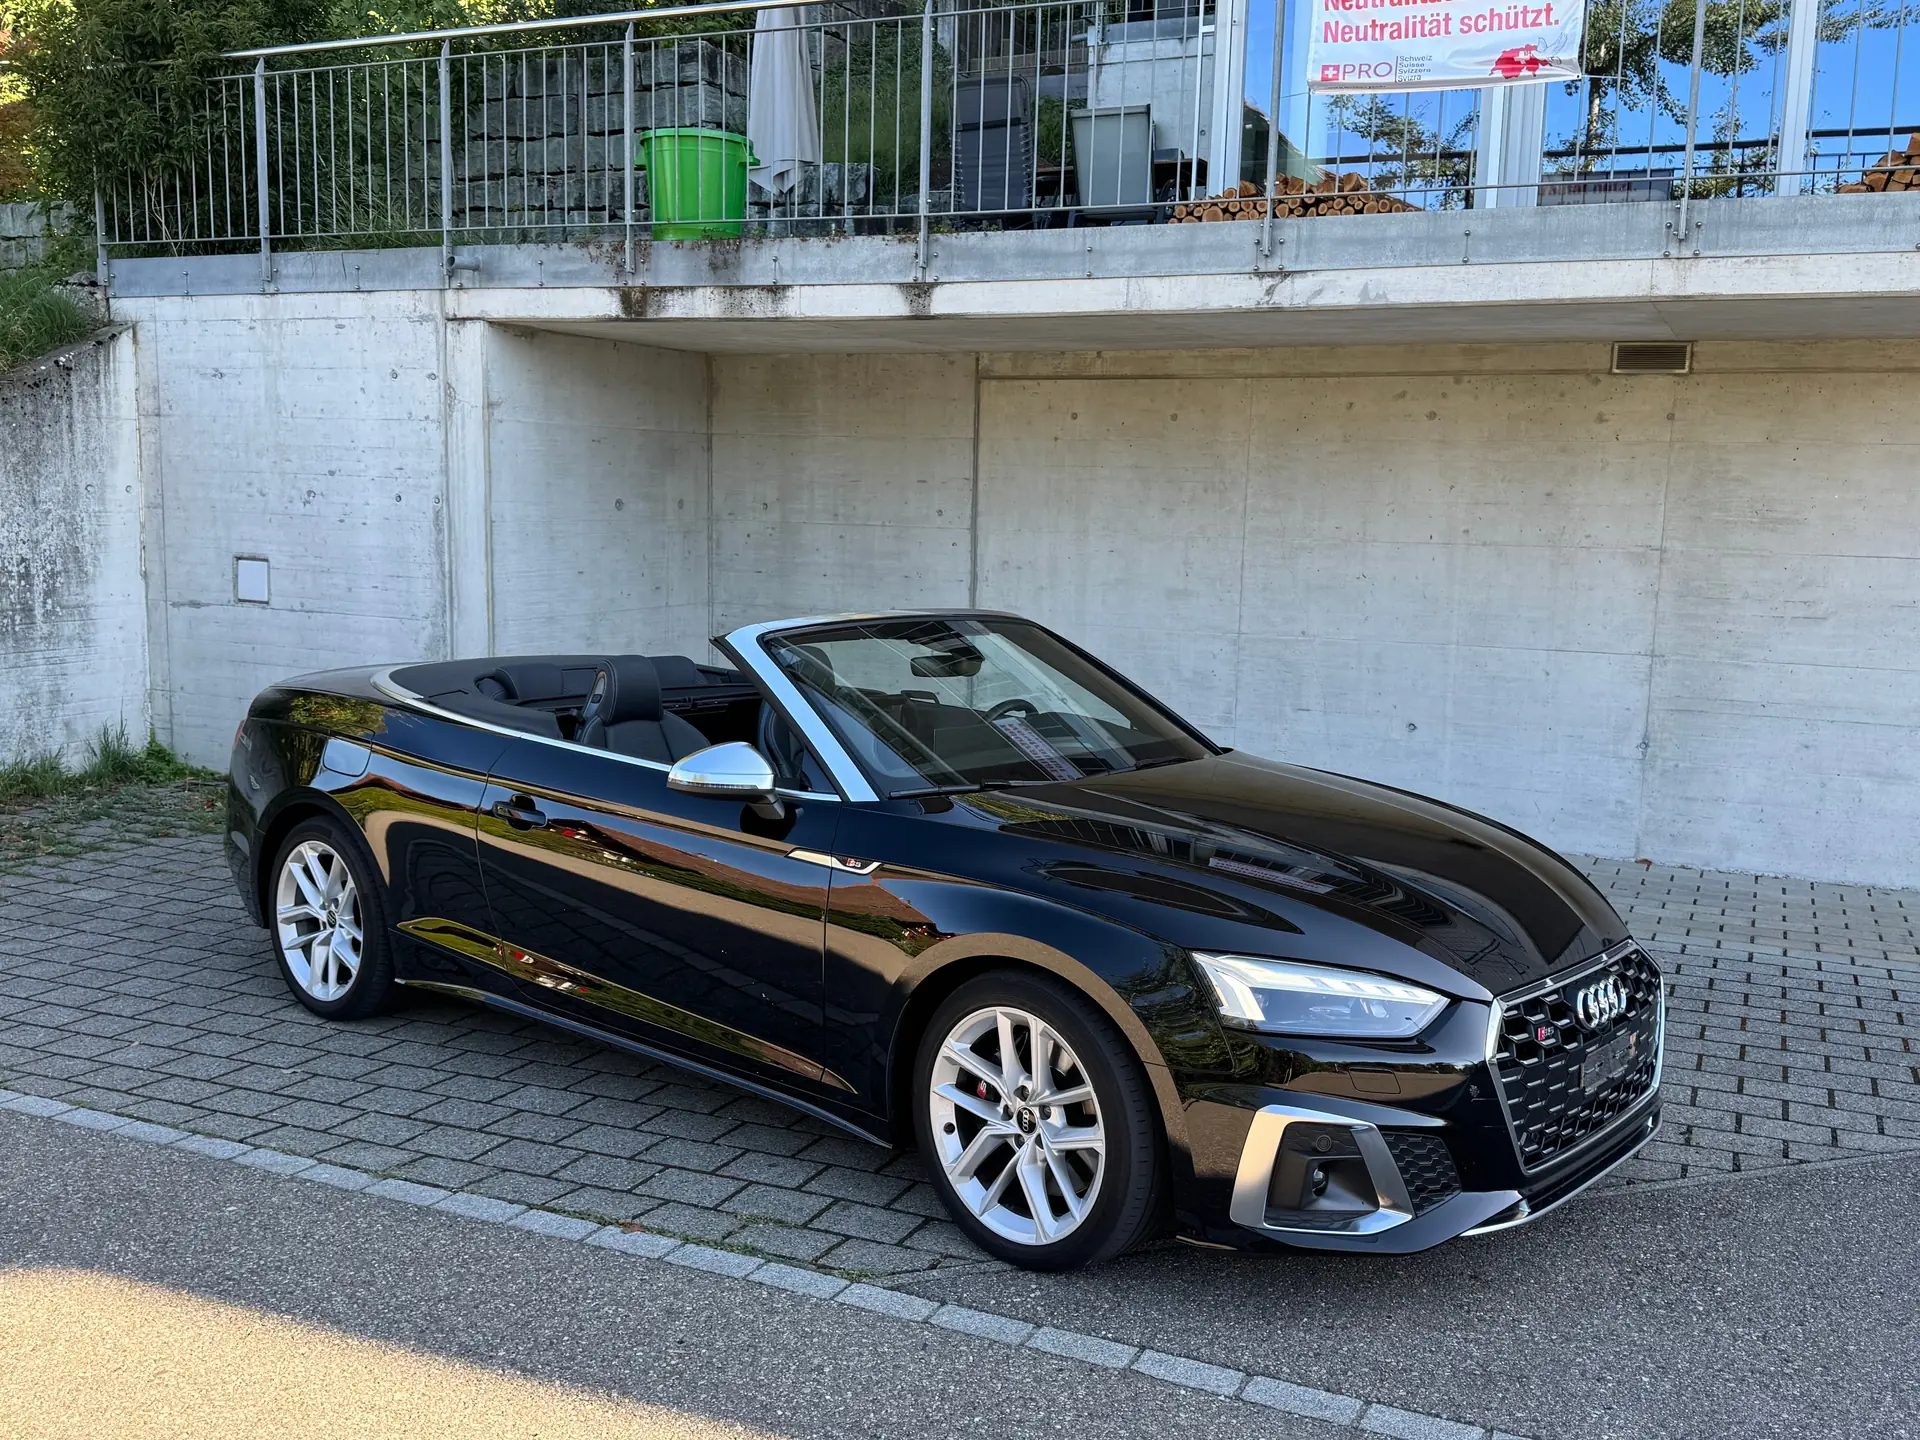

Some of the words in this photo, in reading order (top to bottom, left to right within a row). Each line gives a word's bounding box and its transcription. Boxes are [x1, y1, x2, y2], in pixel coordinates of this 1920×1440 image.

[1323, 12, 1452, 43] Neutralität
[1460, 3, 1560, 34] schützt.
[1342, 62, 1393, 80] PRO
[1397, 75, 1422, 83] Svizra
